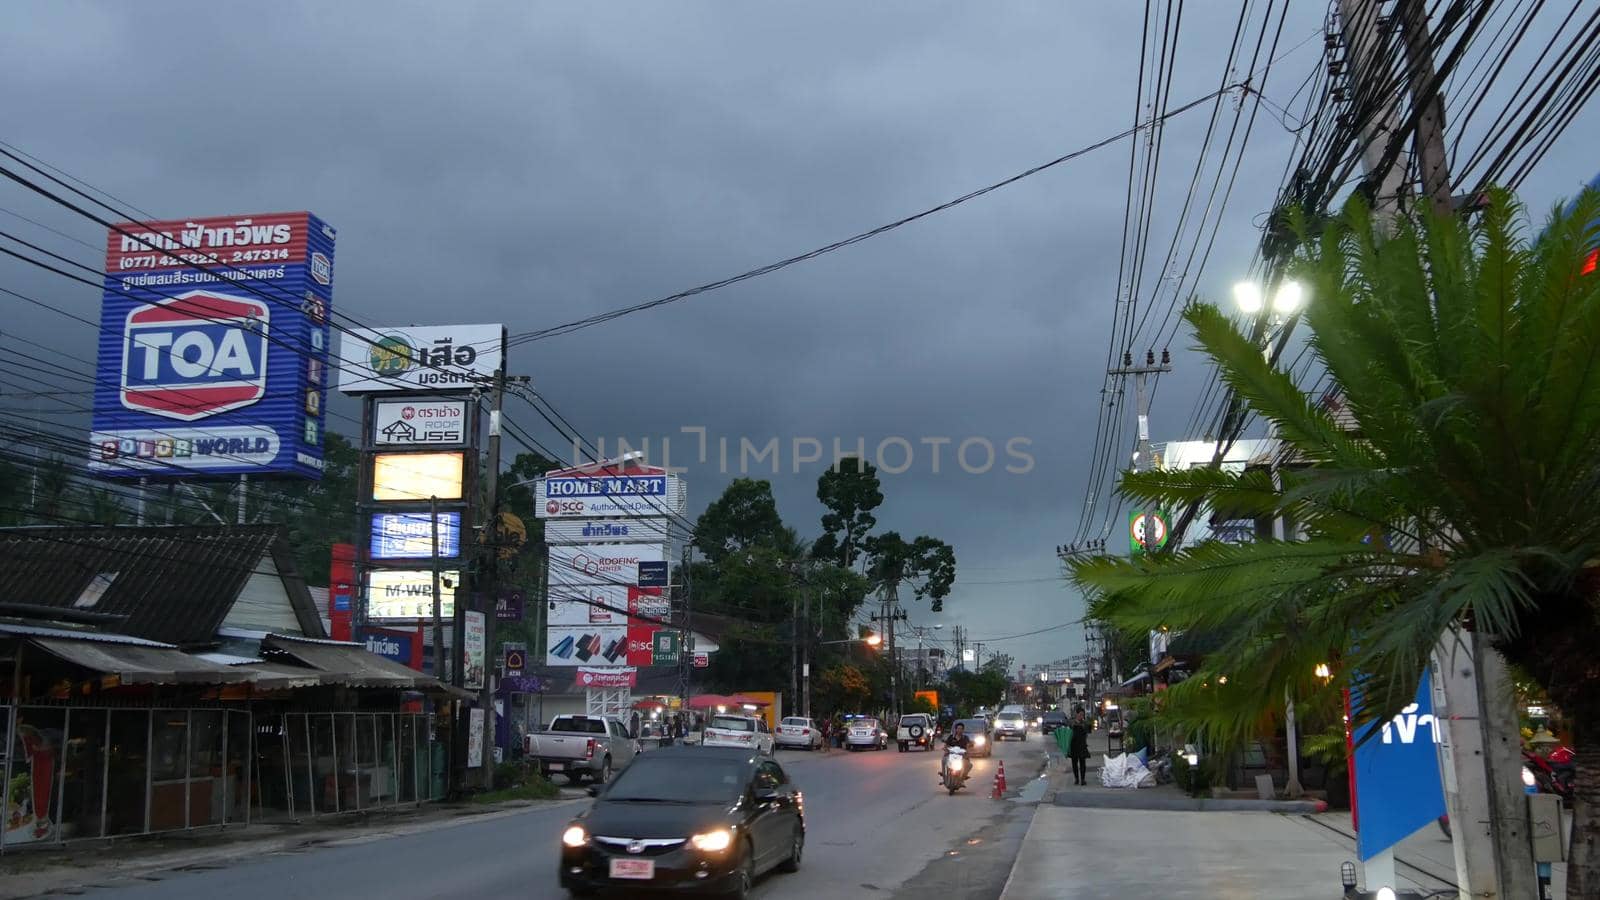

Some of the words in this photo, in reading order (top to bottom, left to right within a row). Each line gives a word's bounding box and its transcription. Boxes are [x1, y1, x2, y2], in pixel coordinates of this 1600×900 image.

[120, 255, 156, 270] (077)
[232, 248, 289, 262] 247314
[134, 328, 256, 380] TOA
[420, 337, 476, 366] เสือ
[418, 406, 460, 418] ตราช้าง
[424, 420, 460, 429] ROOF
[196, 437, 270, 455] WORLD
[549, 480, 601, 495] HOME
[608, 479, 662, 495] MART
[562, 502, 584, 511] SCG
[599, 556, 639, 566] ROOFING
[640, 642, 653, 650] SC
